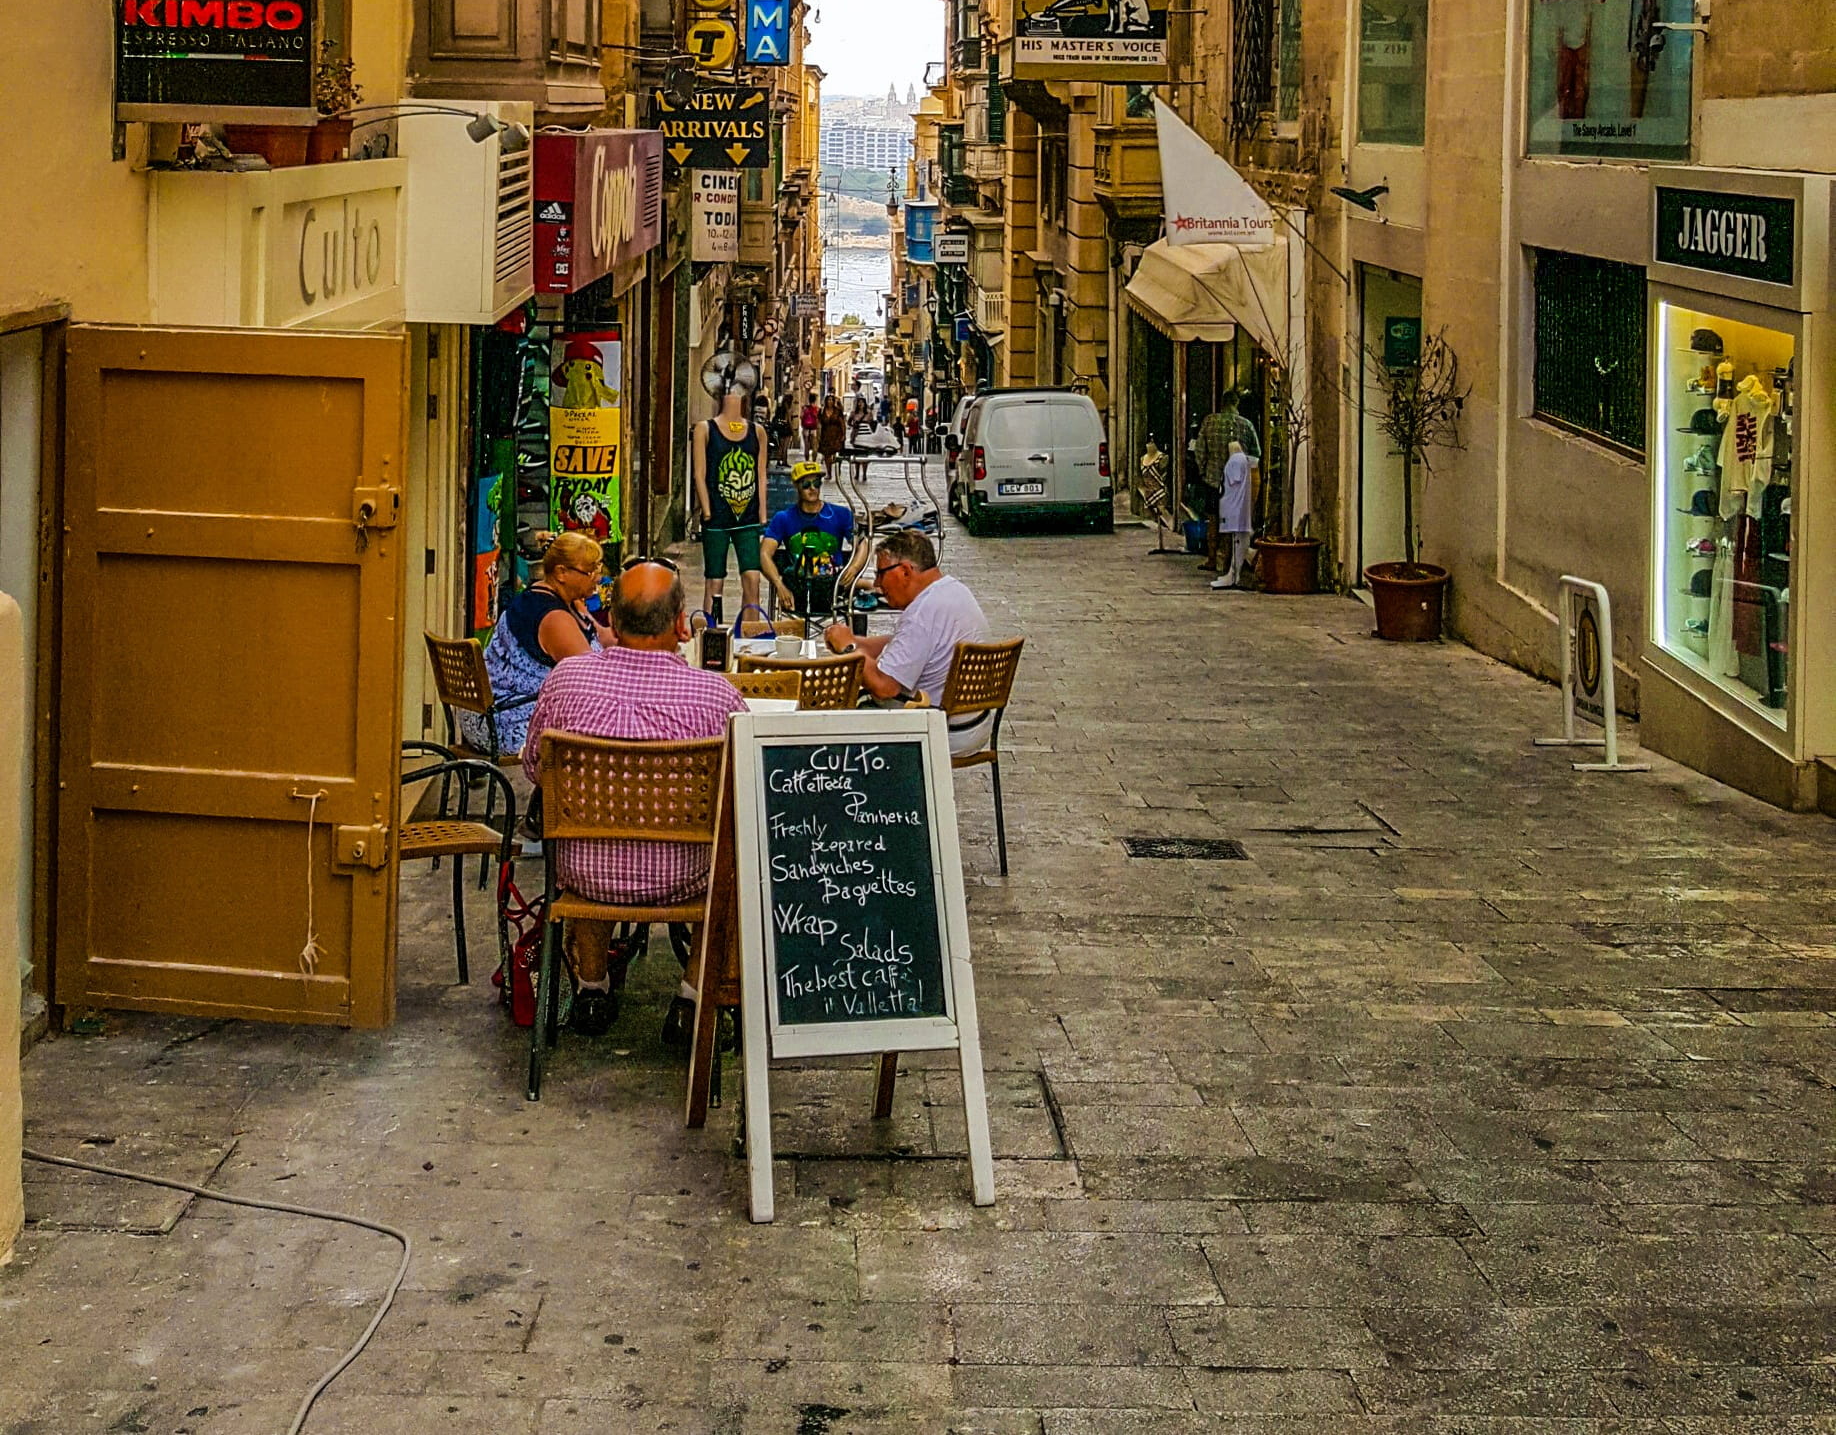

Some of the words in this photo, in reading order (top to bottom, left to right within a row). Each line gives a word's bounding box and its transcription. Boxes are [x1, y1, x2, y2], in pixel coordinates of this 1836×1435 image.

[122, 31, 210, 46] ESPRESSO
[1021, 39, 1043, 51] HIS
[1050, 40, 1115, 52] MASTER'S
[1123, 41, 1162, 53] VOICE
[685, 93, 737, 111] NEW
[658, 120, 765, 139] ARRIVALS
[701, 174, 737, 191] CINE
[539, 212, 566, 220] adidas
[1186, 216, 1239, 229] Britannia
[1241, 216, 1273, 229] Tours
[1678, 206, 1768, 263] JAGGER
[299, 197, 382, 307] Culto
[555, 445, 616, 473] SAVE
[553, 476, 613, 502] FRYDAY
[811, 835, 887, 856] prepared
[771, 854, 875, 882] Sandwiches
[817, 867, 916, 907] Baguettes
[774, 902, 838, 947] Wrap
[838, 926, 913, 965] Salads
[814, 962, 858, 992] best
